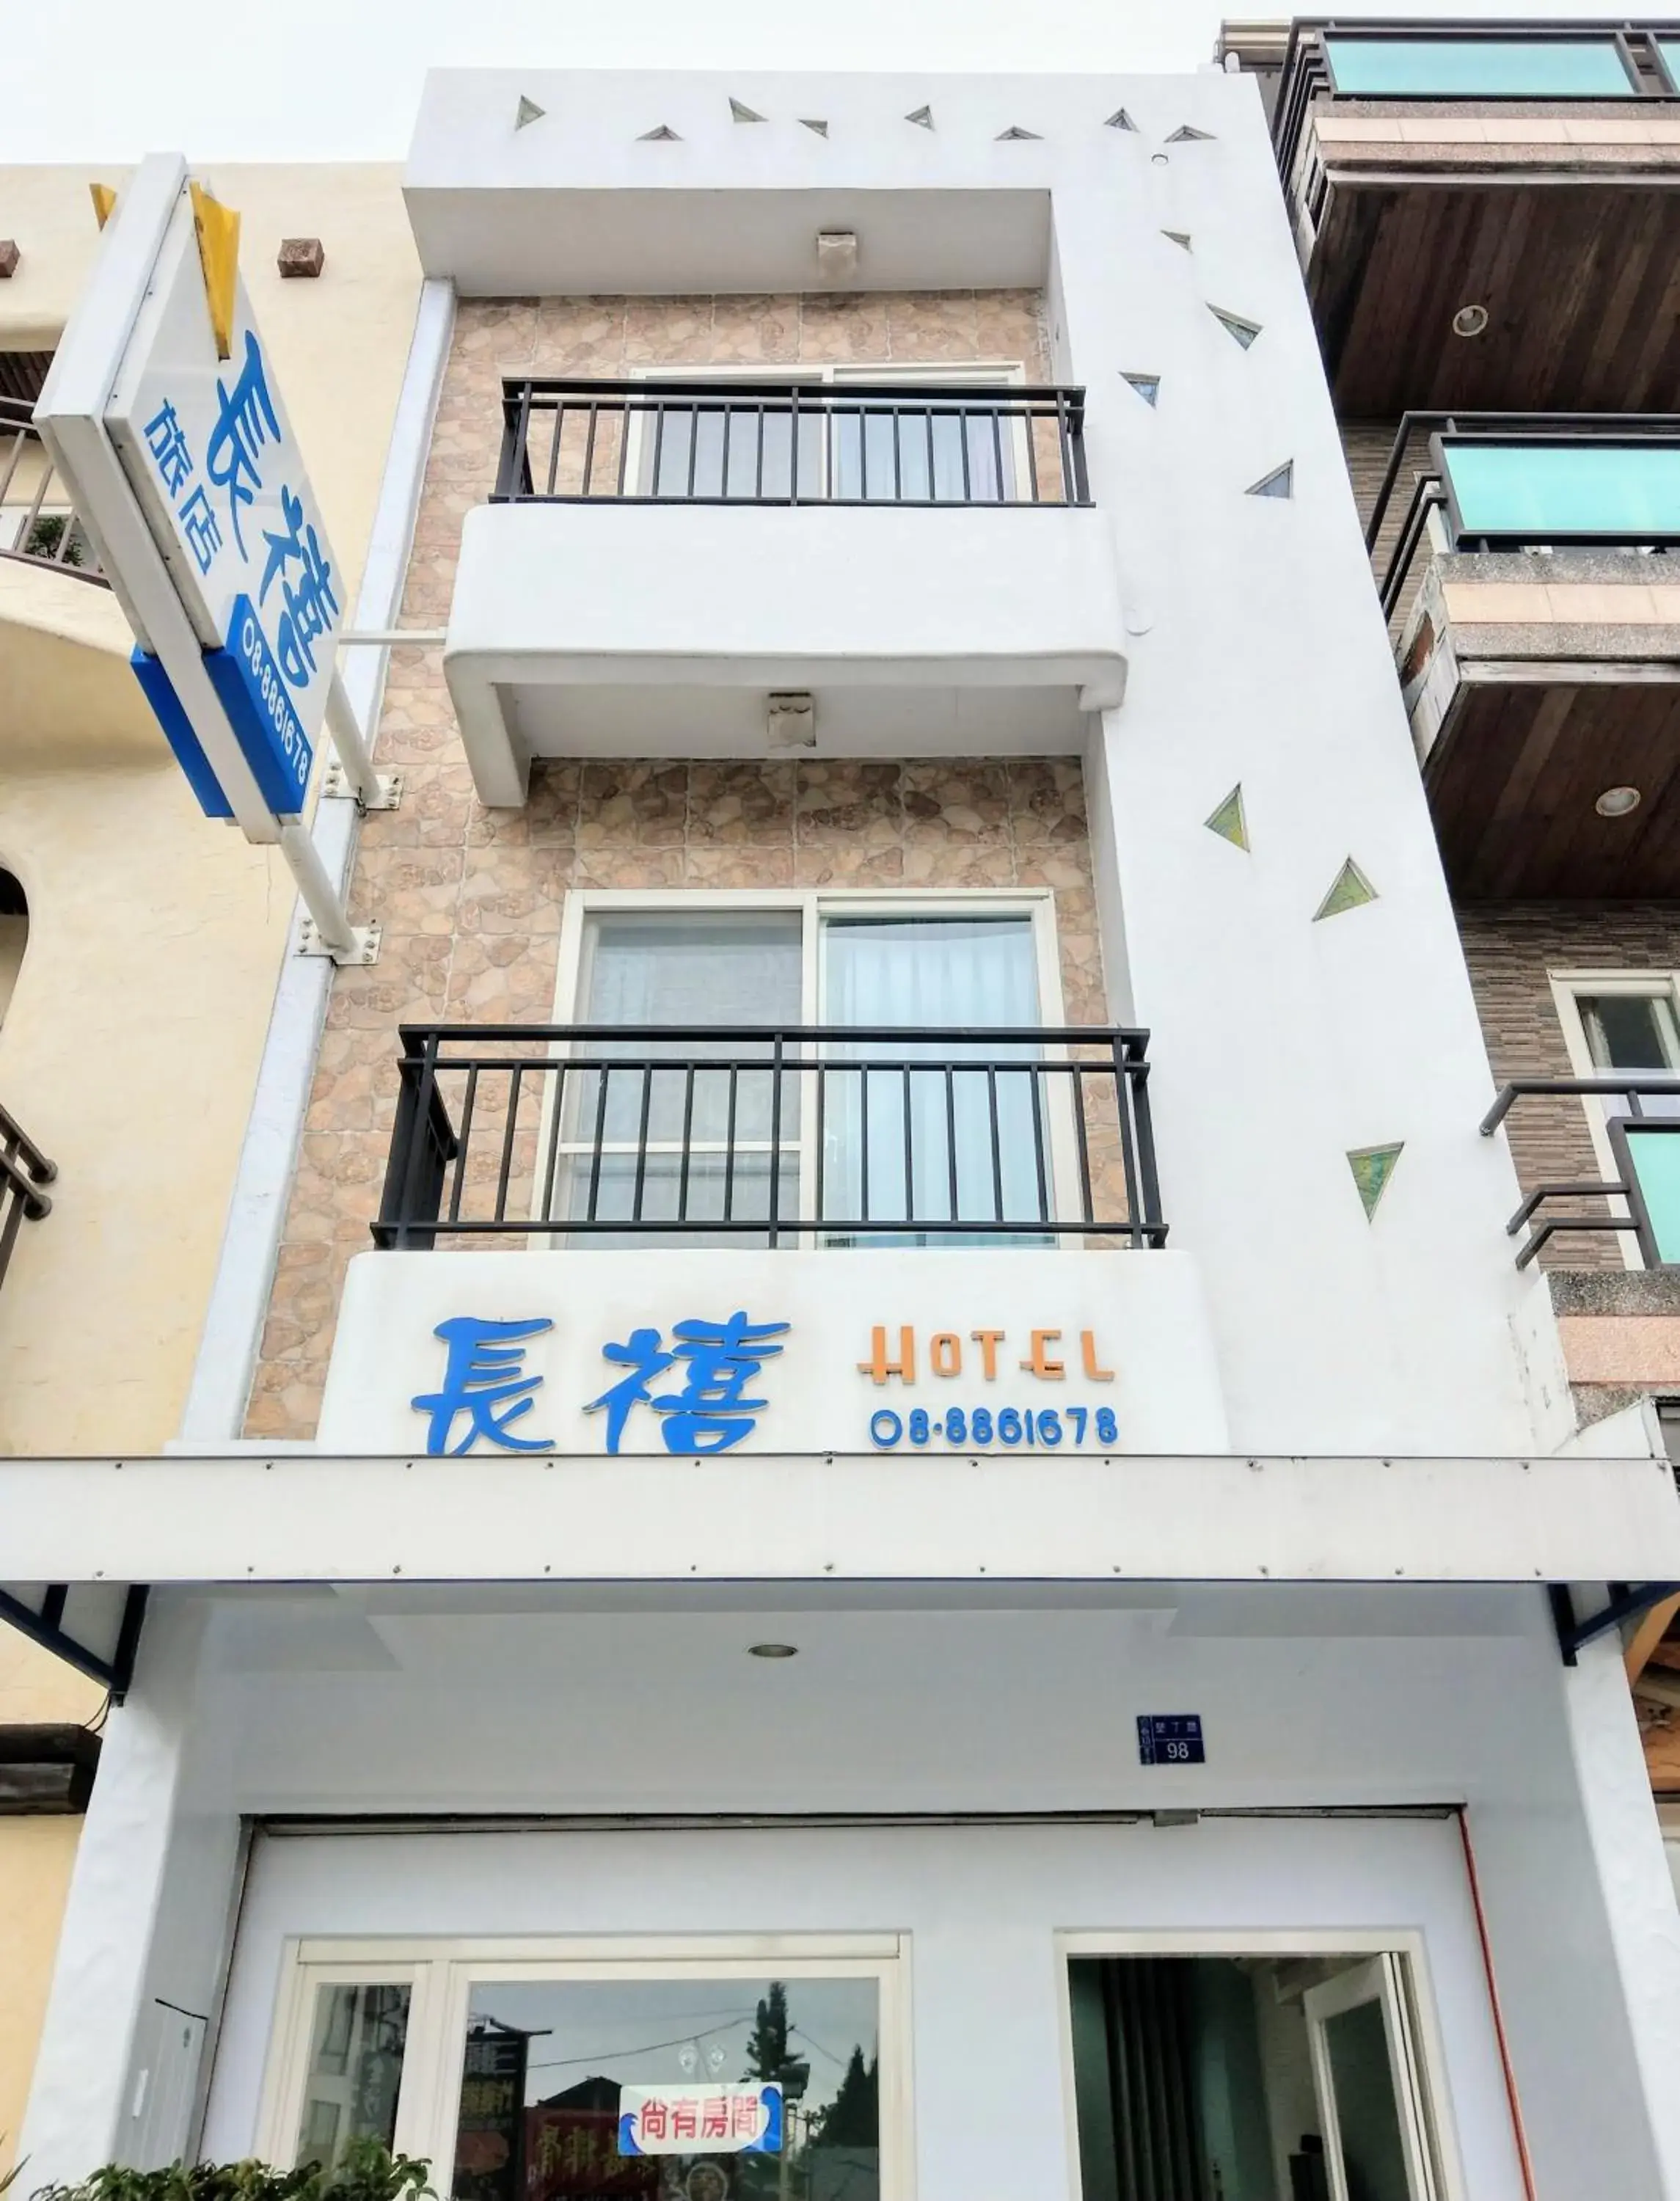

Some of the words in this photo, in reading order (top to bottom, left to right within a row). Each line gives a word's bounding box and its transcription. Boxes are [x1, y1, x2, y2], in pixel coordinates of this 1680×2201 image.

[143, 398, 223, 576] 旅店
[206, 329, 339, 688] 長禧
[410, 1311, 791, 1456] 長禧
[1166, 1741, 1190, 1759] 98
[641, 2096, 759, 2140] 尚有房間
